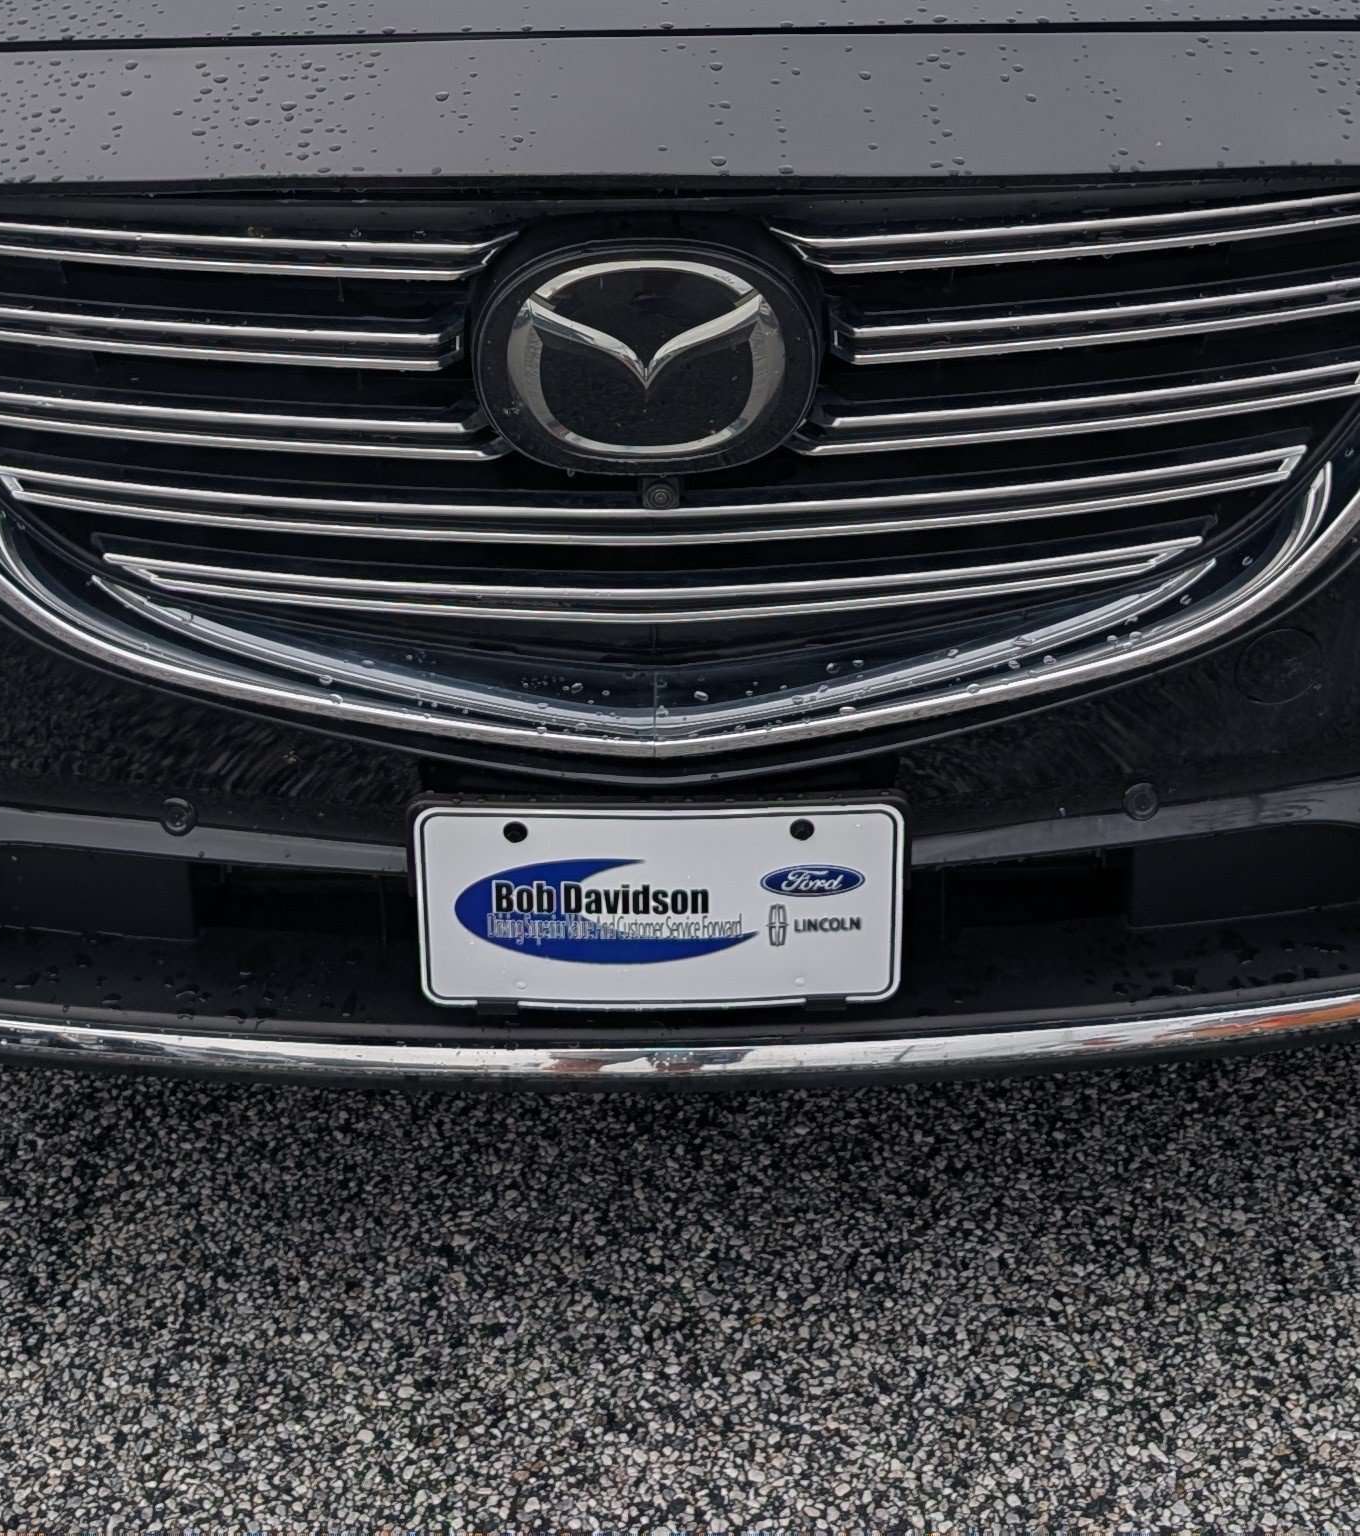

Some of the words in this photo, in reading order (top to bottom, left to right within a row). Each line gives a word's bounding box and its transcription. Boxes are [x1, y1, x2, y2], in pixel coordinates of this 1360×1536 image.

[780, 869, 845, 892] Ford
[494, 881, 554, 914] Bob
[562, 882, 710, 915] Davidson
[617, 915, 665, 940] Customer
[666, 915, 701, 939] Service
[702, 913, 743, 939] Forward
[793, 916, 862, 933] LINCOLN
